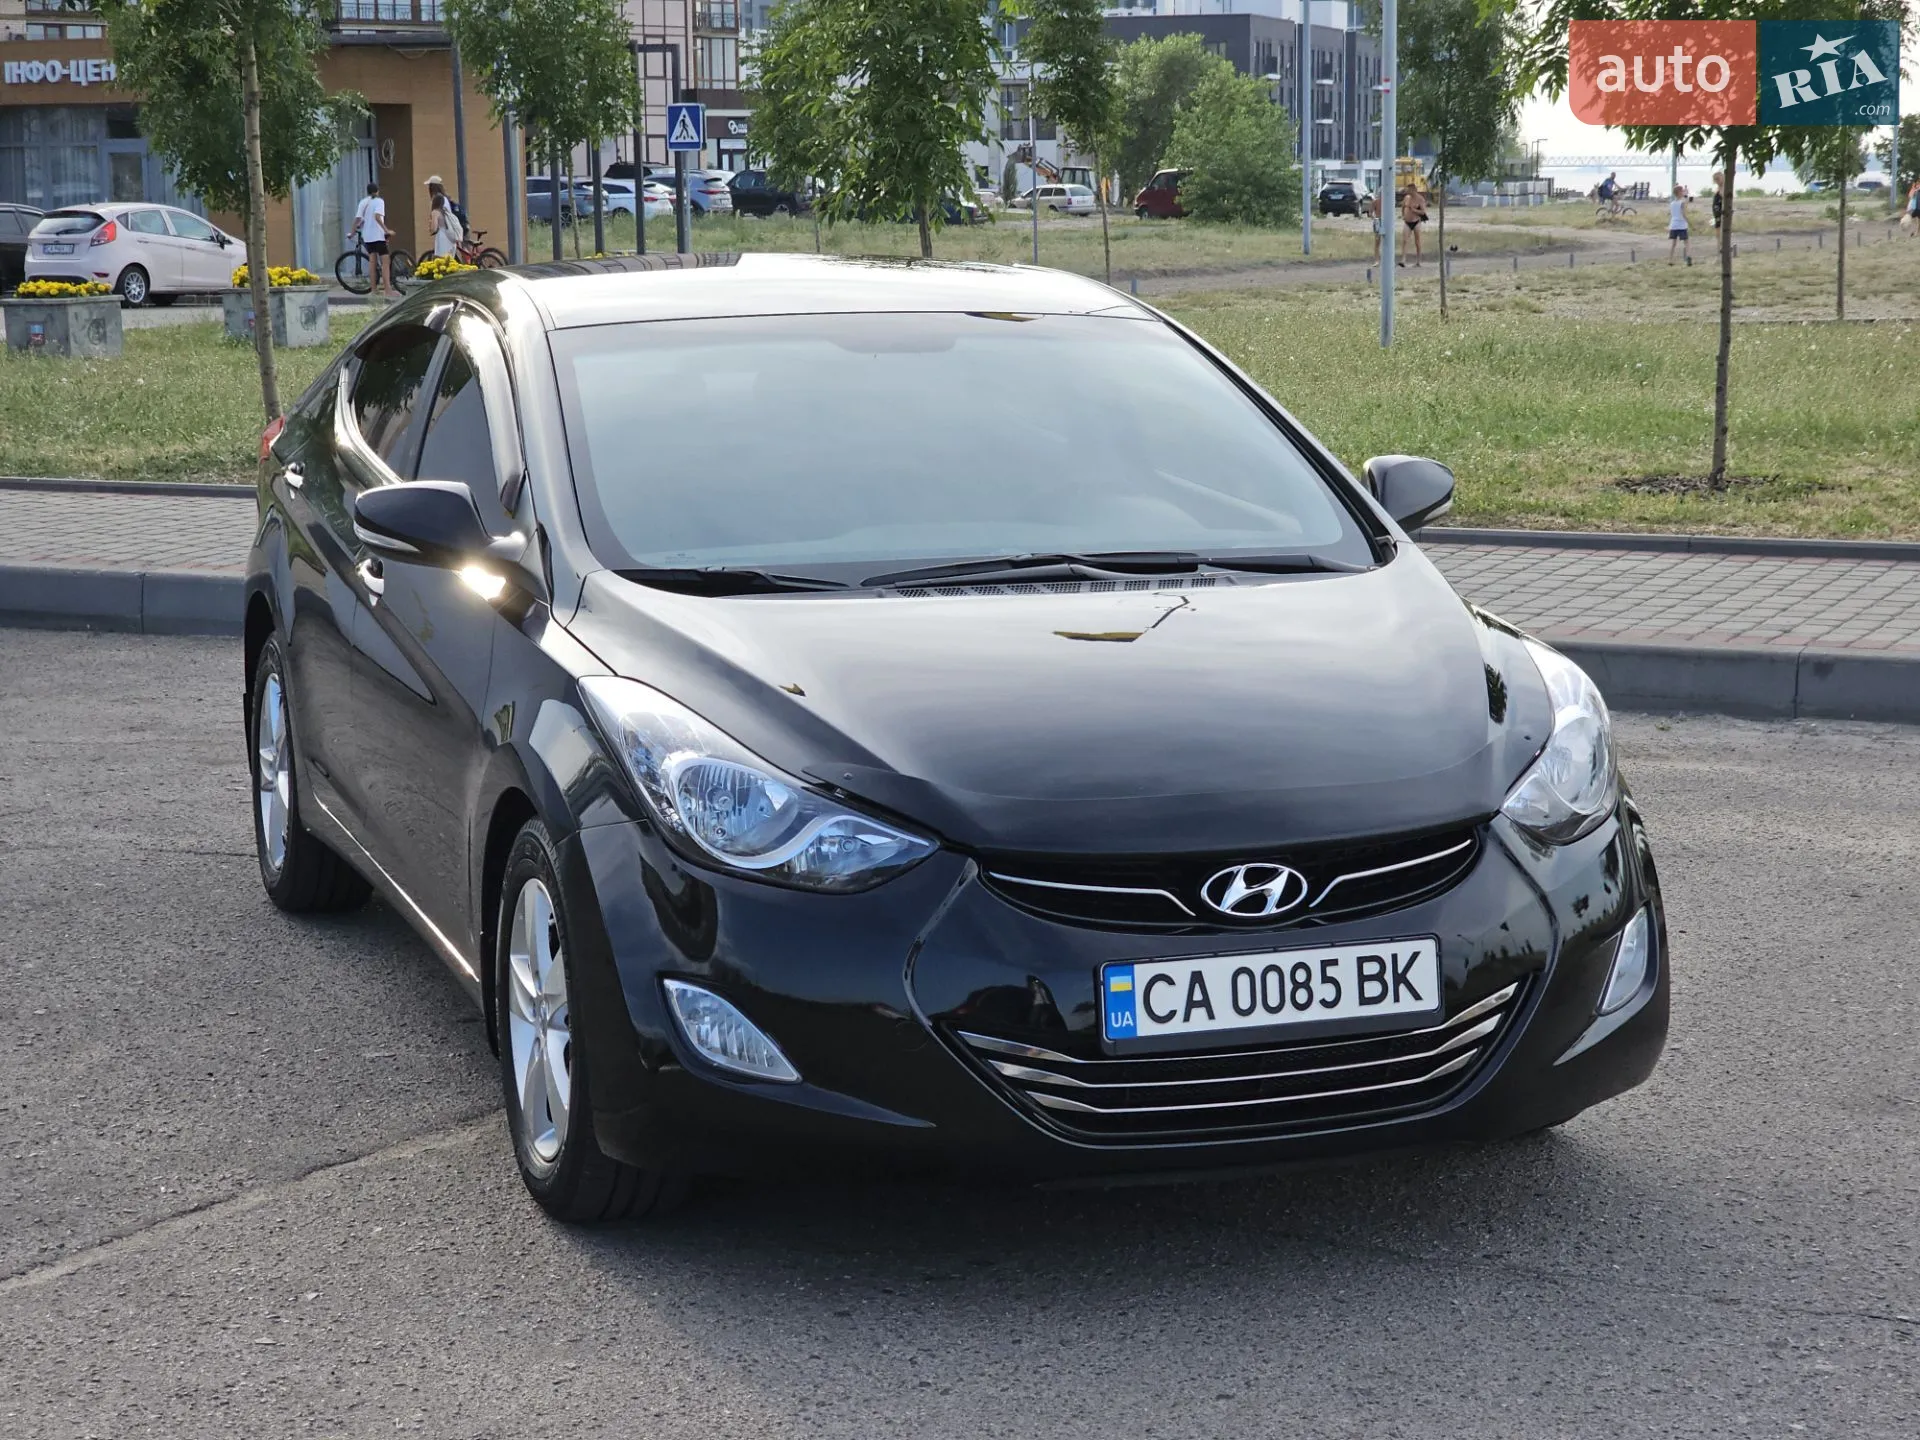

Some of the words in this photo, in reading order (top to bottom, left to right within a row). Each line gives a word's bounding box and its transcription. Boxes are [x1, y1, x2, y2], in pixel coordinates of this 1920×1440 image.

[4, 59, 117, 86] ІНФО-ЦЕН
[1143, 970, 1216, 1025] CA
[1231, 957, 1342, 1017] 0085
[1356, 950, 1424, 1006] BK
[1111, 1011, 1134, 1028] UA
